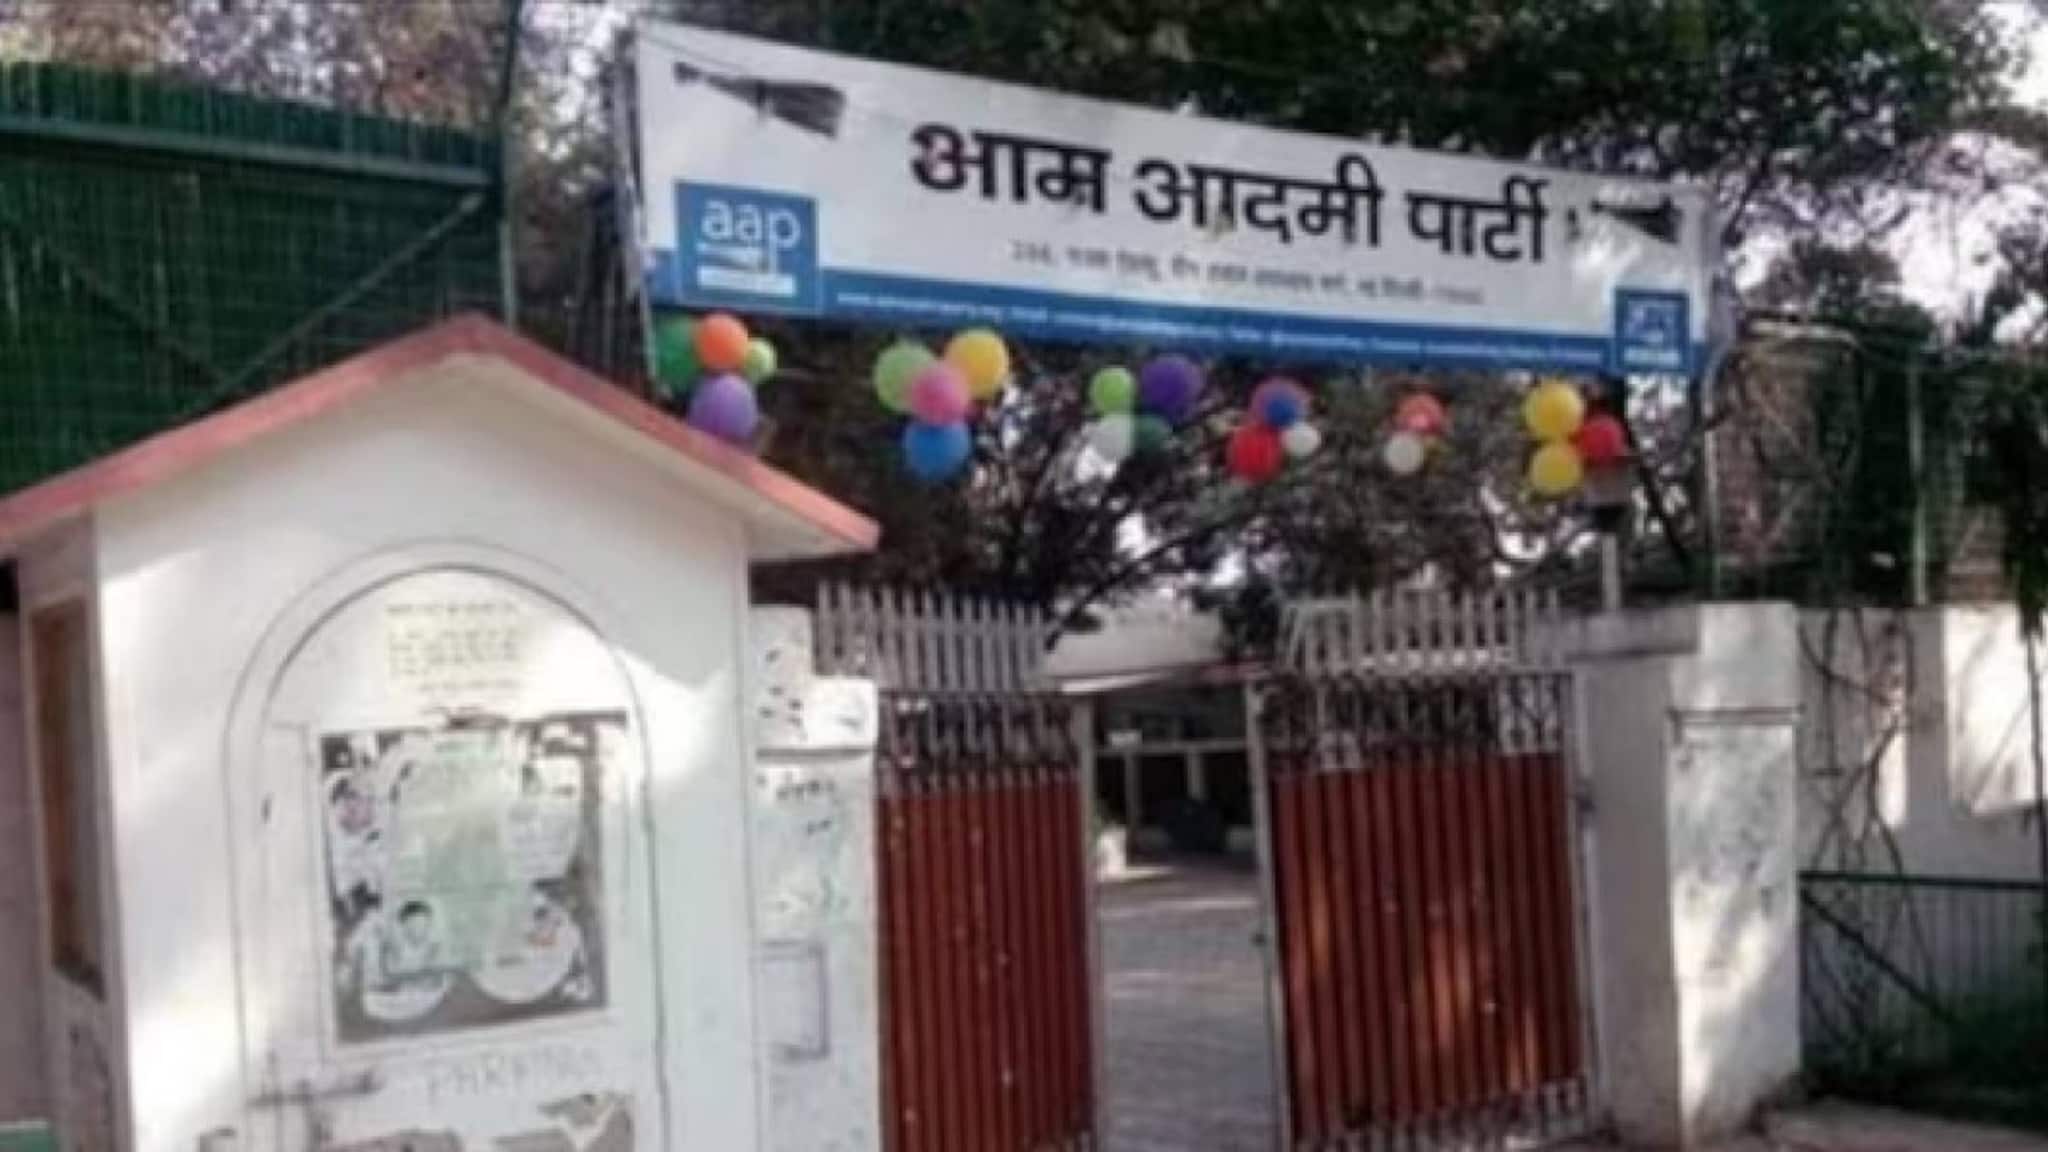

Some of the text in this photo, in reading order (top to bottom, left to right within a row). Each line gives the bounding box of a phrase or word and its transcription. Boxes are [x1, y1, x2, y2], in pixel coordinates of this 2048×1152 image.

[701, 199, 802, 276] aap
[911, 121, 1551, 263] आम आदमी पार्टी
